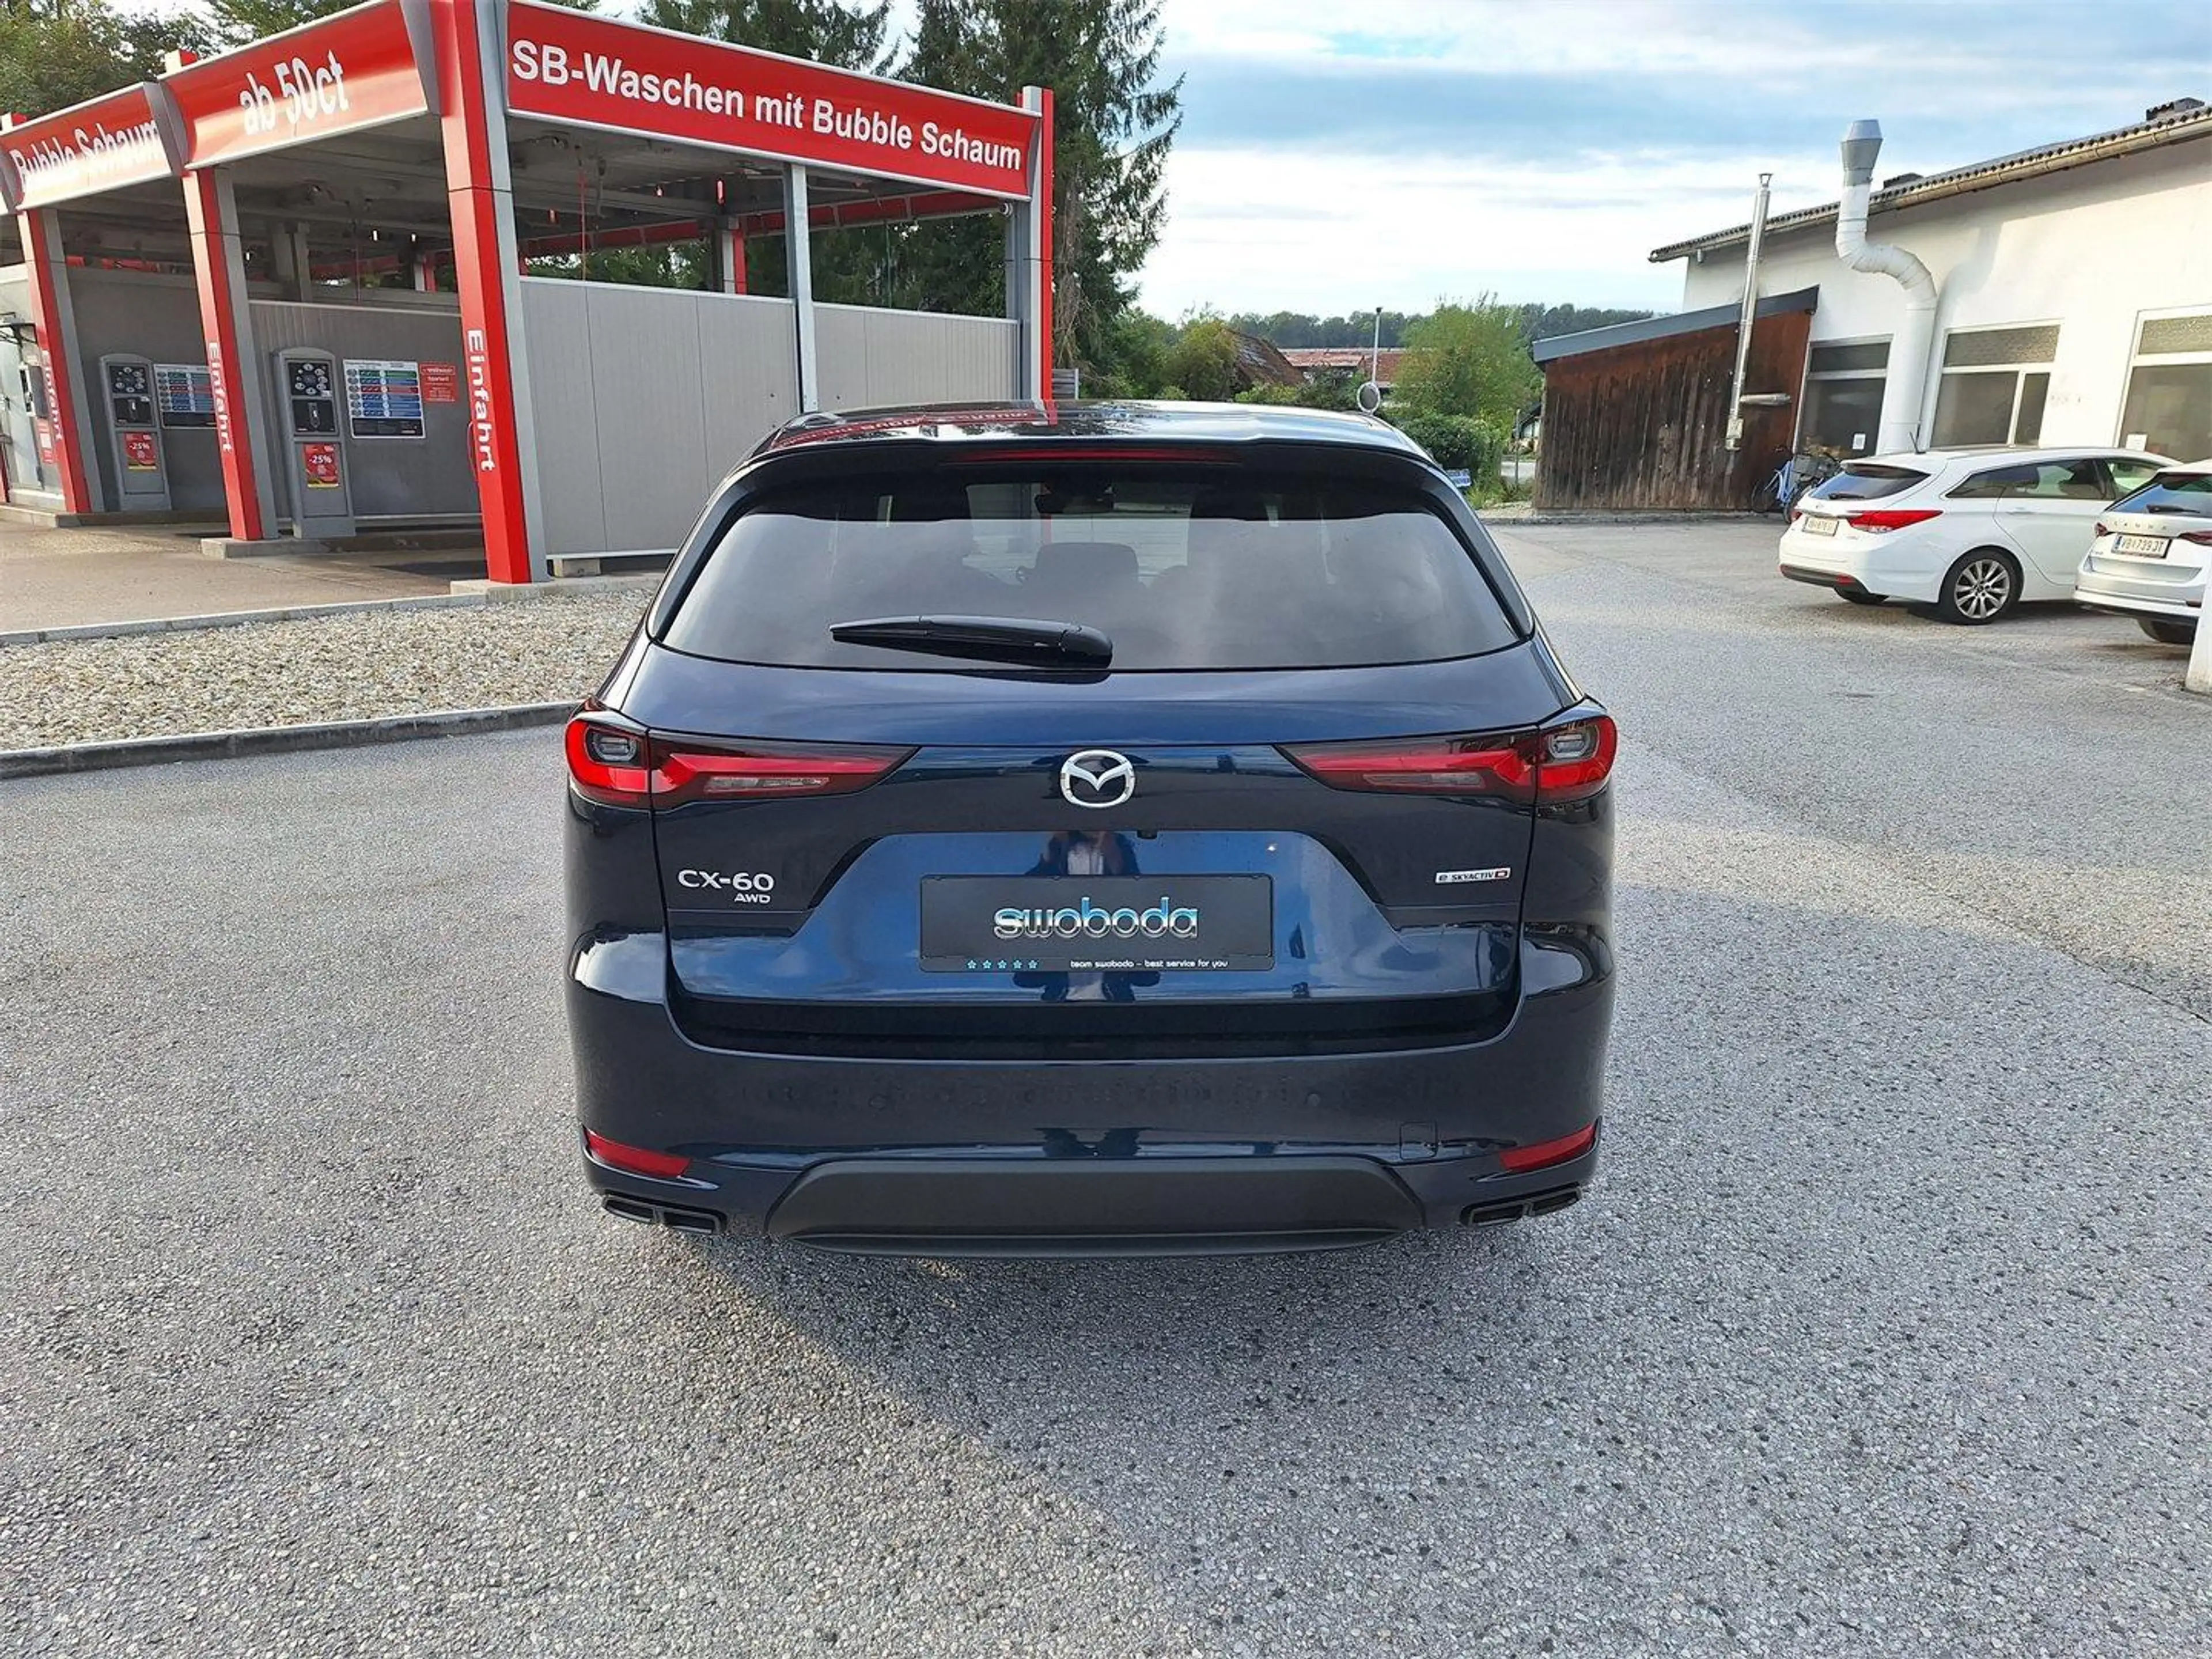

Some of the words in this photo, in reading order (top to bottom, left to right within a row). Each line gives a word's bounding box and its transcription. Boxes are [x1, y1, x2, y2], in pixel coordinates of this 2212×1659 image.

[240, 72, 275, 135] ab
[274, 50, 349, 124] 50ct
[512, 40, 743, 118] SB-Waschen
[755, 93, 804, 128] mit
[813, 99, 912, 149] Bubble
[921, 122, 1021, 171] Schaum
[209, 342, 232, 452] Einfahrt
[467, 330, 495, 471] Einfahrt
[678, 869, 775, 892] CX-60
[734, 893, 771, 904] AWD
[994, 896, 1198, 939] swoboda
[1070, 960, 1093, 968] team
[1095, 959, 1134, 968] swoboda
[1144, 959, 1164, 968] best
[1166, 960, 1196, 968] service
[1198, 959, 1210, 968] for
[1211, 960, 1228, 968] you
